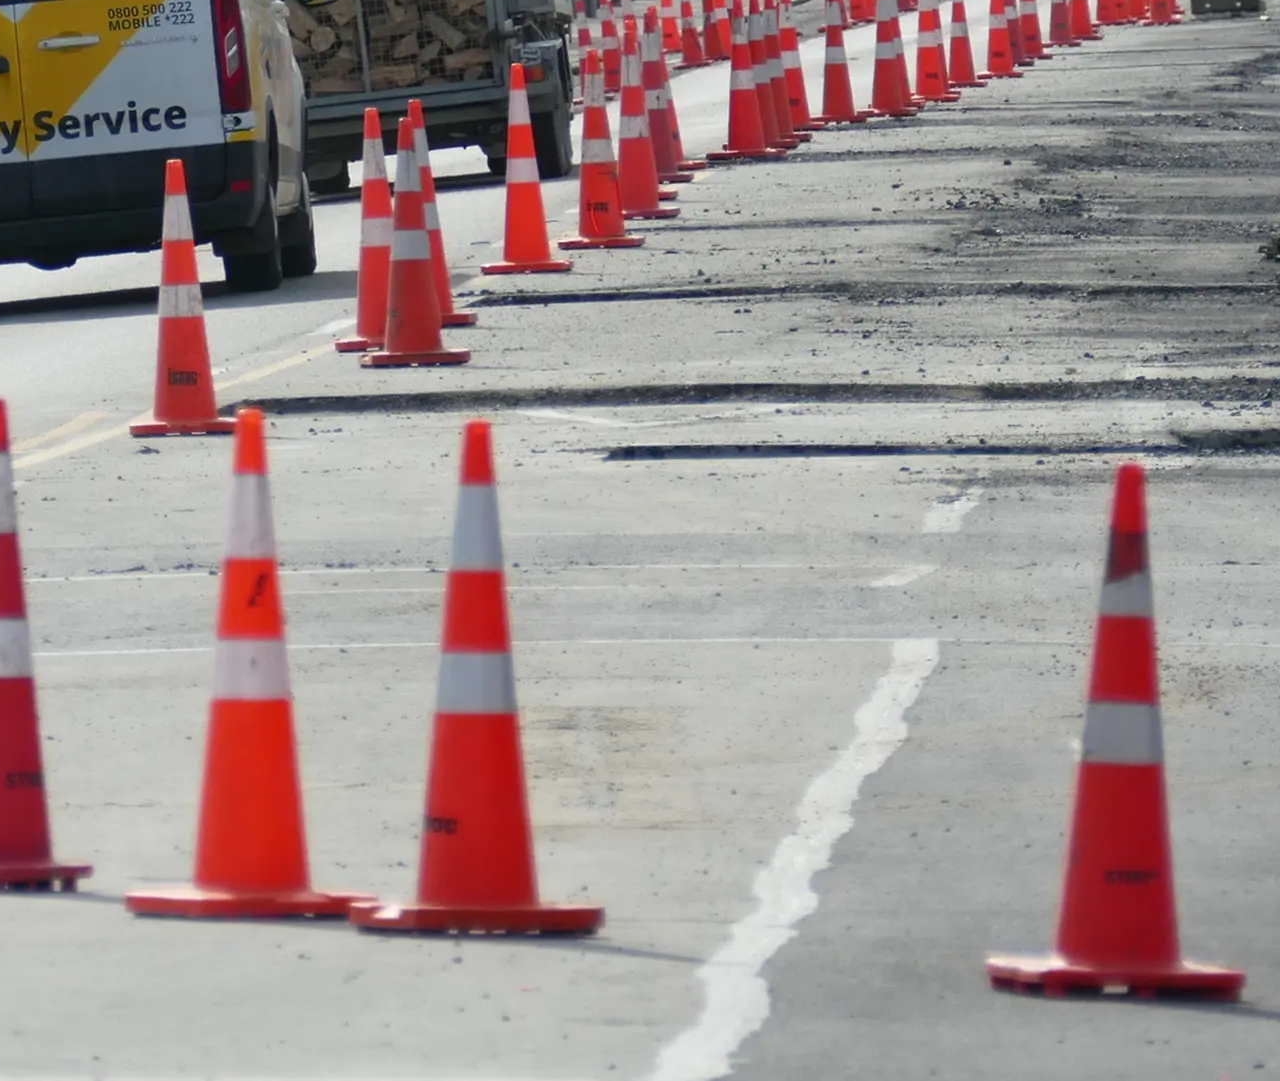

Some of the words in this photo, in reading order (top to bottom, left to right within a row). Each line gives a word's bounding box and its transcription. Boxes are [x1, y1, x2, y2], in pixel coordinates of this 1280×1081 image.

[108, 6, 140, 19] 0800
[142, 3, 165, 16] 500
[169, 1, 192, 13] 222
[109, 16, 161, 32] MOBILE
[33, 100, 187, 142] Service
